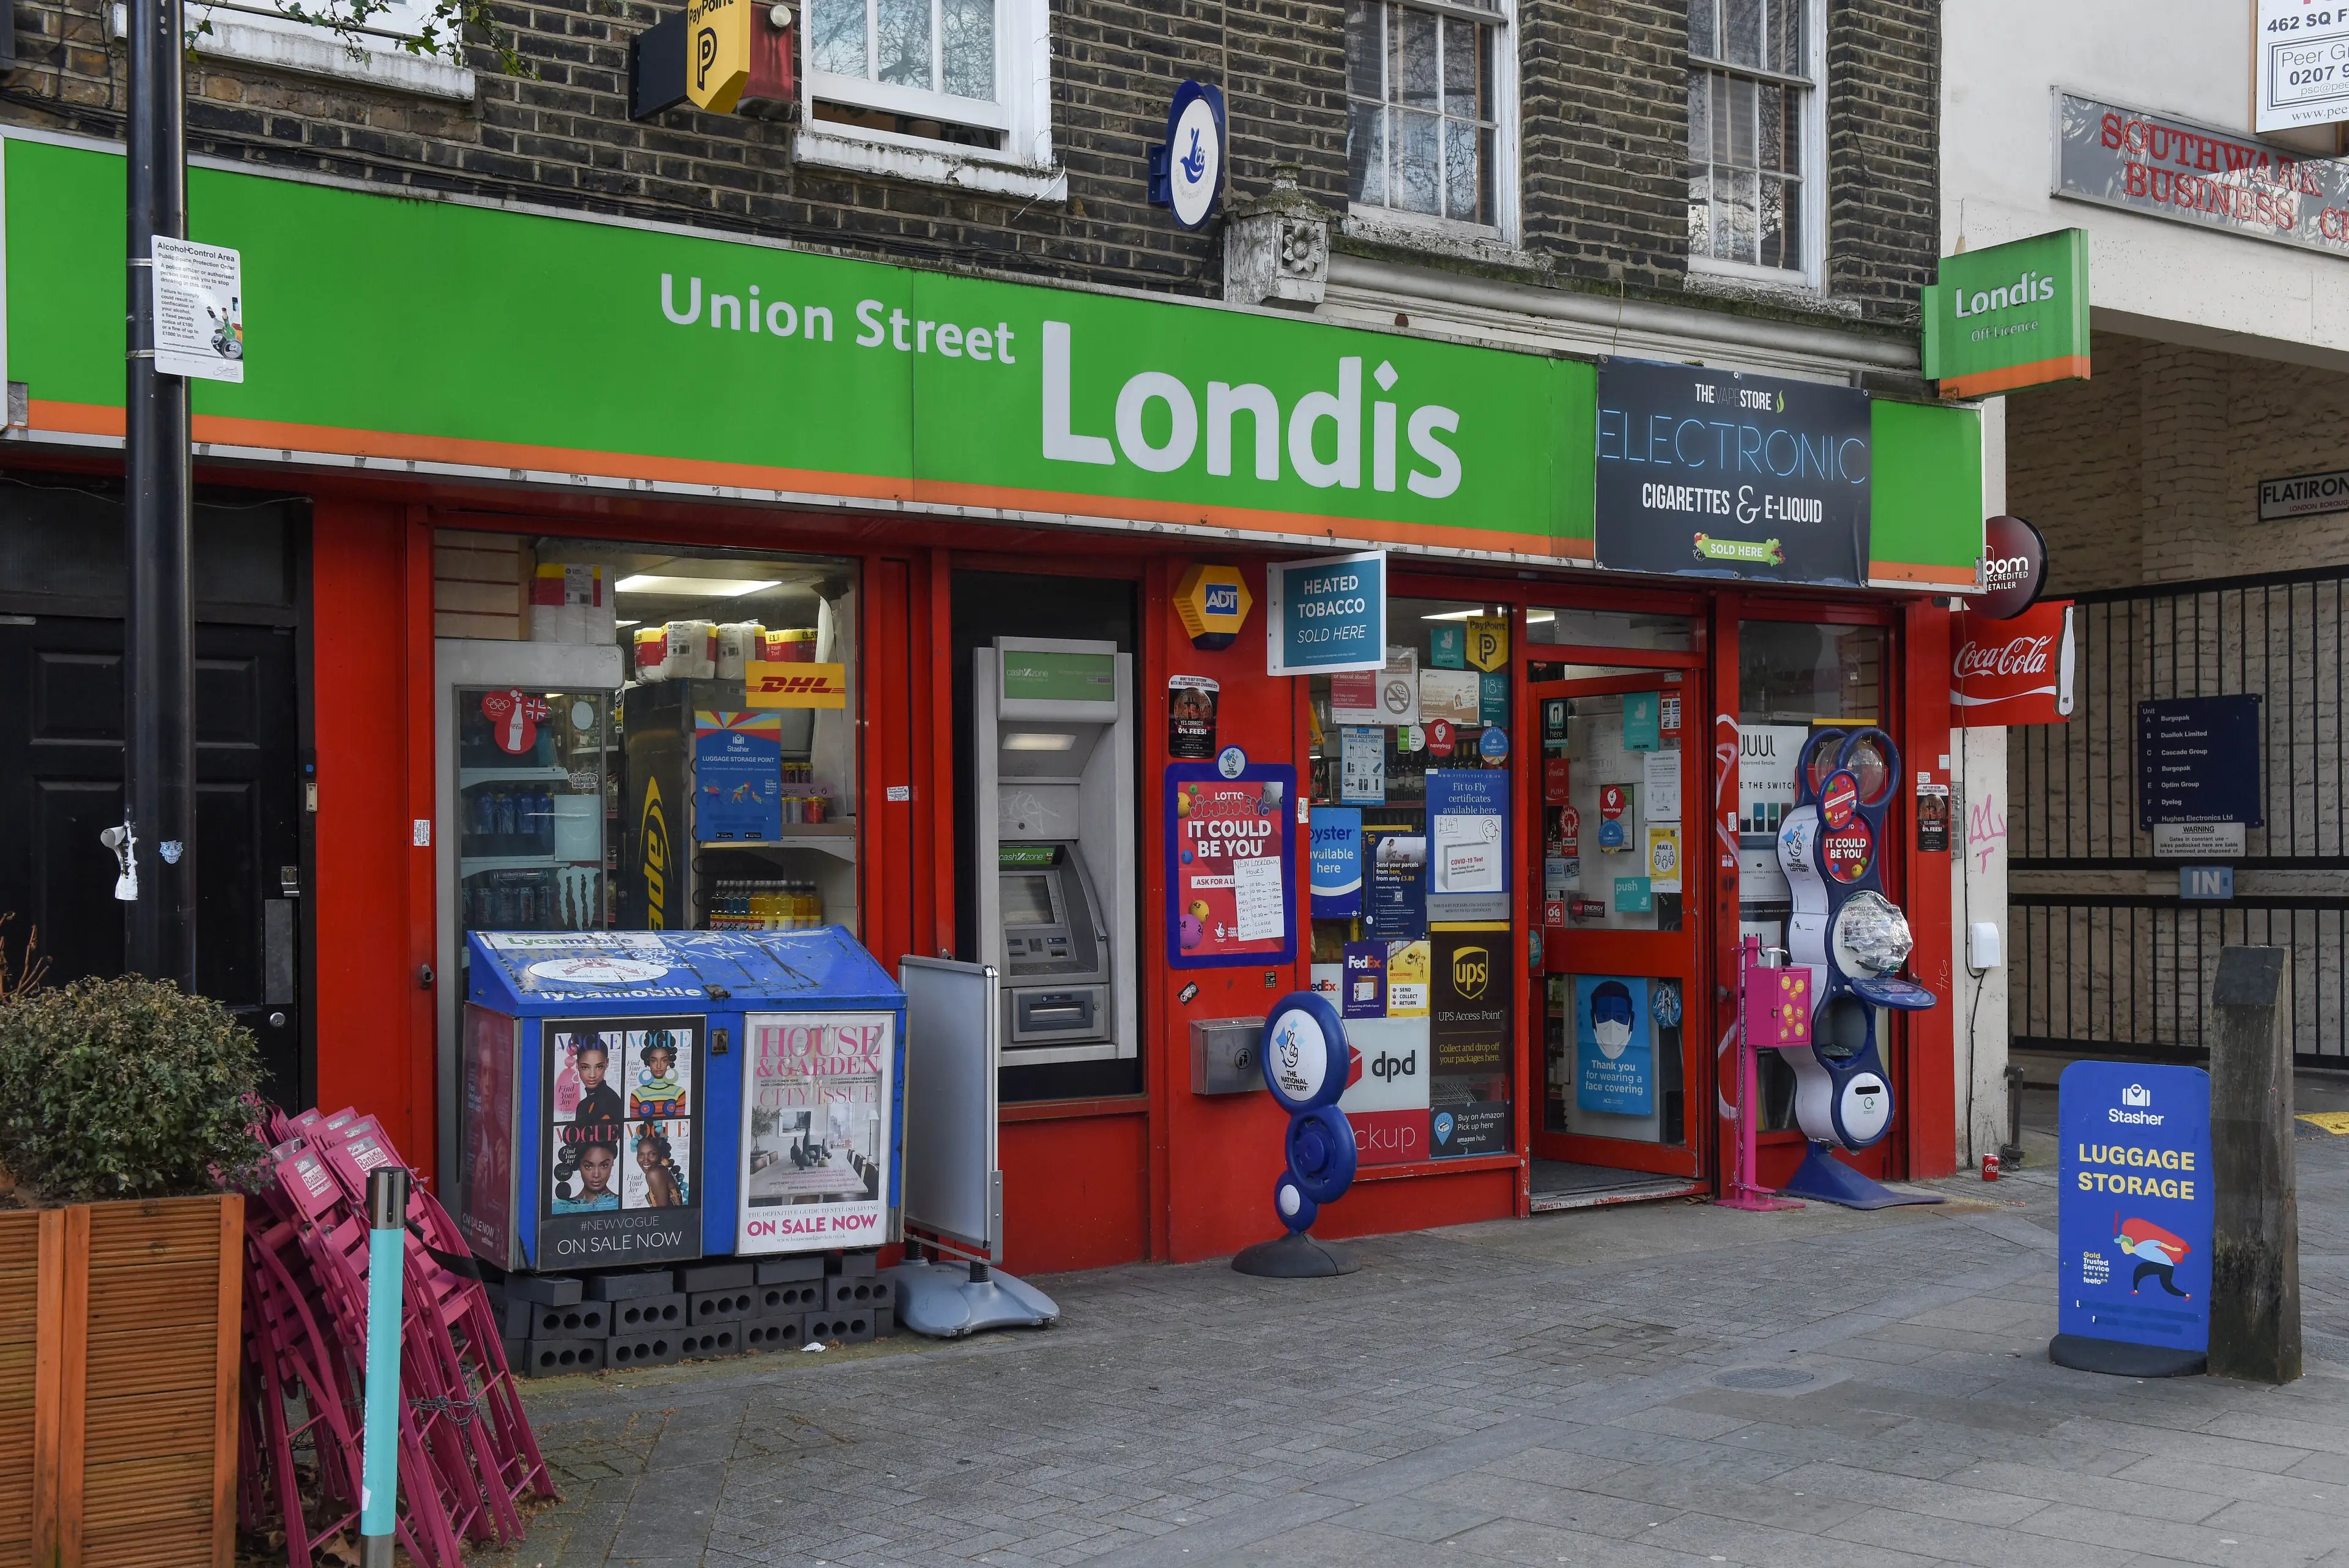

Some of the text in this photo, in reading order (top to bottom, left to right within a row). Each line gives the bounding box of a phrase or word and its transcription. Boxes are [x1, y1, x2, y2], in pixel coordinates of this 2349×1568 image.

[689, 0, 733, 27] PayPoint
[2268, 12, 2331, 32] 462 SQ
[2282, 50, 2324, 67] Peer
[2290, 66, 2335, 85] 0207
[2101, 113, 2323, 197] SOUTHWARK
[2124, 160, 2295, 230] BUSINESS
[157, 242, 234, 262] Alcohol Control Area
[193, 259, 219, 267] Protection
[207, 270, 234, 280] authorised
[1956, 270, 2054, 318] Londis
[661, 273, 1015, 364] Union Street
[1972, 321, 2038, 341] Off-Licence
[1042, 321, 1461, 499] Londis
[1597, 409, 1865, 484] ELECTRONIC
[1642, 483, 1822, 524] CIGARETTES & E-LIQUID
[2320, 499, 2349, 508] BOROUG
[1710, 543, 1763, 557] SOLD HERE
[1305, 576, 1358, 595] HEATED
[1987, 582, 2016, 591] ETAILER
[1206, 591, 1237, 608] ADT
[1298, 598, 1365, 619] TOBACCO
[1297, 625, 1366, 644] SOLD HERE
[1470, 621, 1505, 630] PayPoint
[1954, 636, 2053, 678] Coca-Cola
[760, 677, 833, 693] DHL
[1740, 735, 1776, 757] JUUL
[1475, 783, 1486, 793] Fly
[1449, 793, 1490, 803] certificates
[1443, 806, 1496, 814] available here
[1188, 820, 1271, 838] IT COULD
[1198, 839, 1263, 857] BE YOU
[1310, 849, 1353, 859] vailable
[1234, 858, 1279, 869] NEW LOCKDOWN
[1317, 863, 1340, 872] here
[1616, 880, 1637, 894] push
[2192, 871, 2221, 894] IN
[1349, 955, 1381, 968] FedEx
[540, 987, 703, 1001] lycamobile
[1439, 1012, 1454, 1021] UPS
[1456, 1011, 1480, 1020] Access
[629, 1030, 690, 1048] VOGUE
[759, 1026, 880, 1057] HOUSE
[1439, 1044, 1461, 1052] Collect
[1475, 1043, 1490, 1053] drop
[1491, 1042, 1500, 1050] off
[757, 1055, 880, 1077] & GARDEN
[1372, 1050, 1415, 1083] dpd
[1439, 1056, 1453, 1065] your
[1455, 1054, 1483, 1065] packages
[1592, 1060, 1636, 1072] Thank you
[1281, 1077, 1308, 1085] NATIONAL
[1586, 1071, 1598, 1079] for
[1600, 1072, 1634, 1083] wearing
[760, 1086, 877, 1106] CITY ISSUE
[1586, 1081, 1642, 1096] face covering
[1458, 1114, 1469, 1123] Buy
[2109, 1109, 2164, 1126] Stasher
[357, 1149, 386, 1169] Bankside
[2079, 1143, 2194, 1171] LUGGAGE
[2078, 1172, 2194, 1200] STORAGE
[581, 1216, 659, 1231] #NEWVOGUE
[748, 1214, 877, 1236] ON SALE NOW
[558, 1231, 682, 1255] ON SALE NOW
